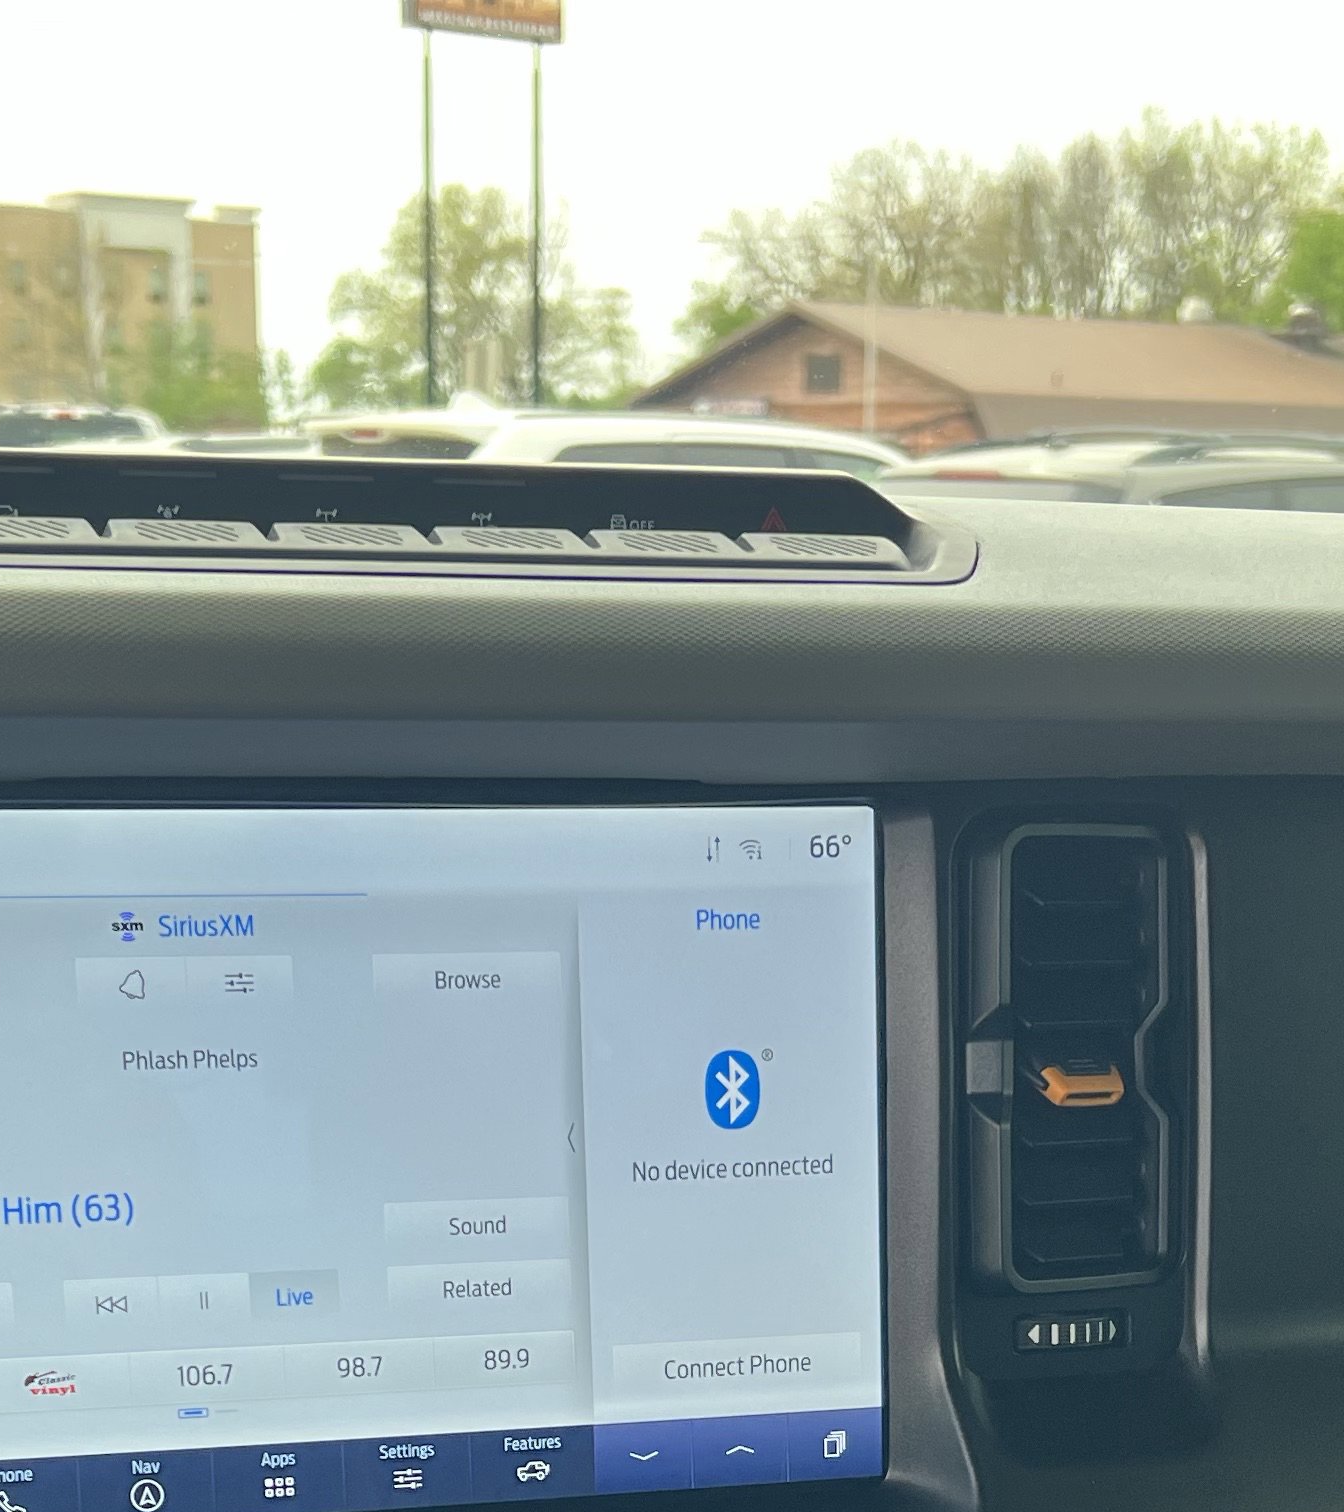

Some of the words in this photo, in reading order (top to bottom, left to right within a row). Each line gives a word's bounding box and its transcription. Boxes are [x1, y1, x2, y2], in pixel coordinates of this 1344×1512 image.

[629, 520, 655, 531] OFF
[809, 835, 852, 859] 66°
[112, 920, 144, 934] sxm
[158, 914, 255, 938] SiriusXM
[696, 909, 760, 931] Phone
[434, 970, 501, 990] Browse
[122, 1050, 187, 1071] Phlash
[193, 1048, 258, 1072] Phelps
[632, 1161, 659, 1182] No
[665, 1158, 727, 1180] device
[732, 1154, 834, 1178] connected
[3, 1196, 62, 1225] Him
[71, 1192, 135, 1228] (63)
[448, 1215, 507, 1236] Sound
[276, 1286, 314, 1307] Live
[443, 1277, 513, 1299] Related
[337, 1356, 383, 1378] 98.7
[484, 1348, 530, 1371] 89.9
[664, 1356, 745, 1381] Connect
[749, 1352, 812, 1375] Phone
[38, 1373, 76, 1386] Classic
[177, 1364, 233, 1386] 106.7
[30, 1384, 76, 1396] vinyl
[379, 1442, 435, 1461] Settings
[503, 1433, 562, 1452] Features
[131, 1458, 161, 1475] Nav
[261, 1450, 296, 1469] Apps
